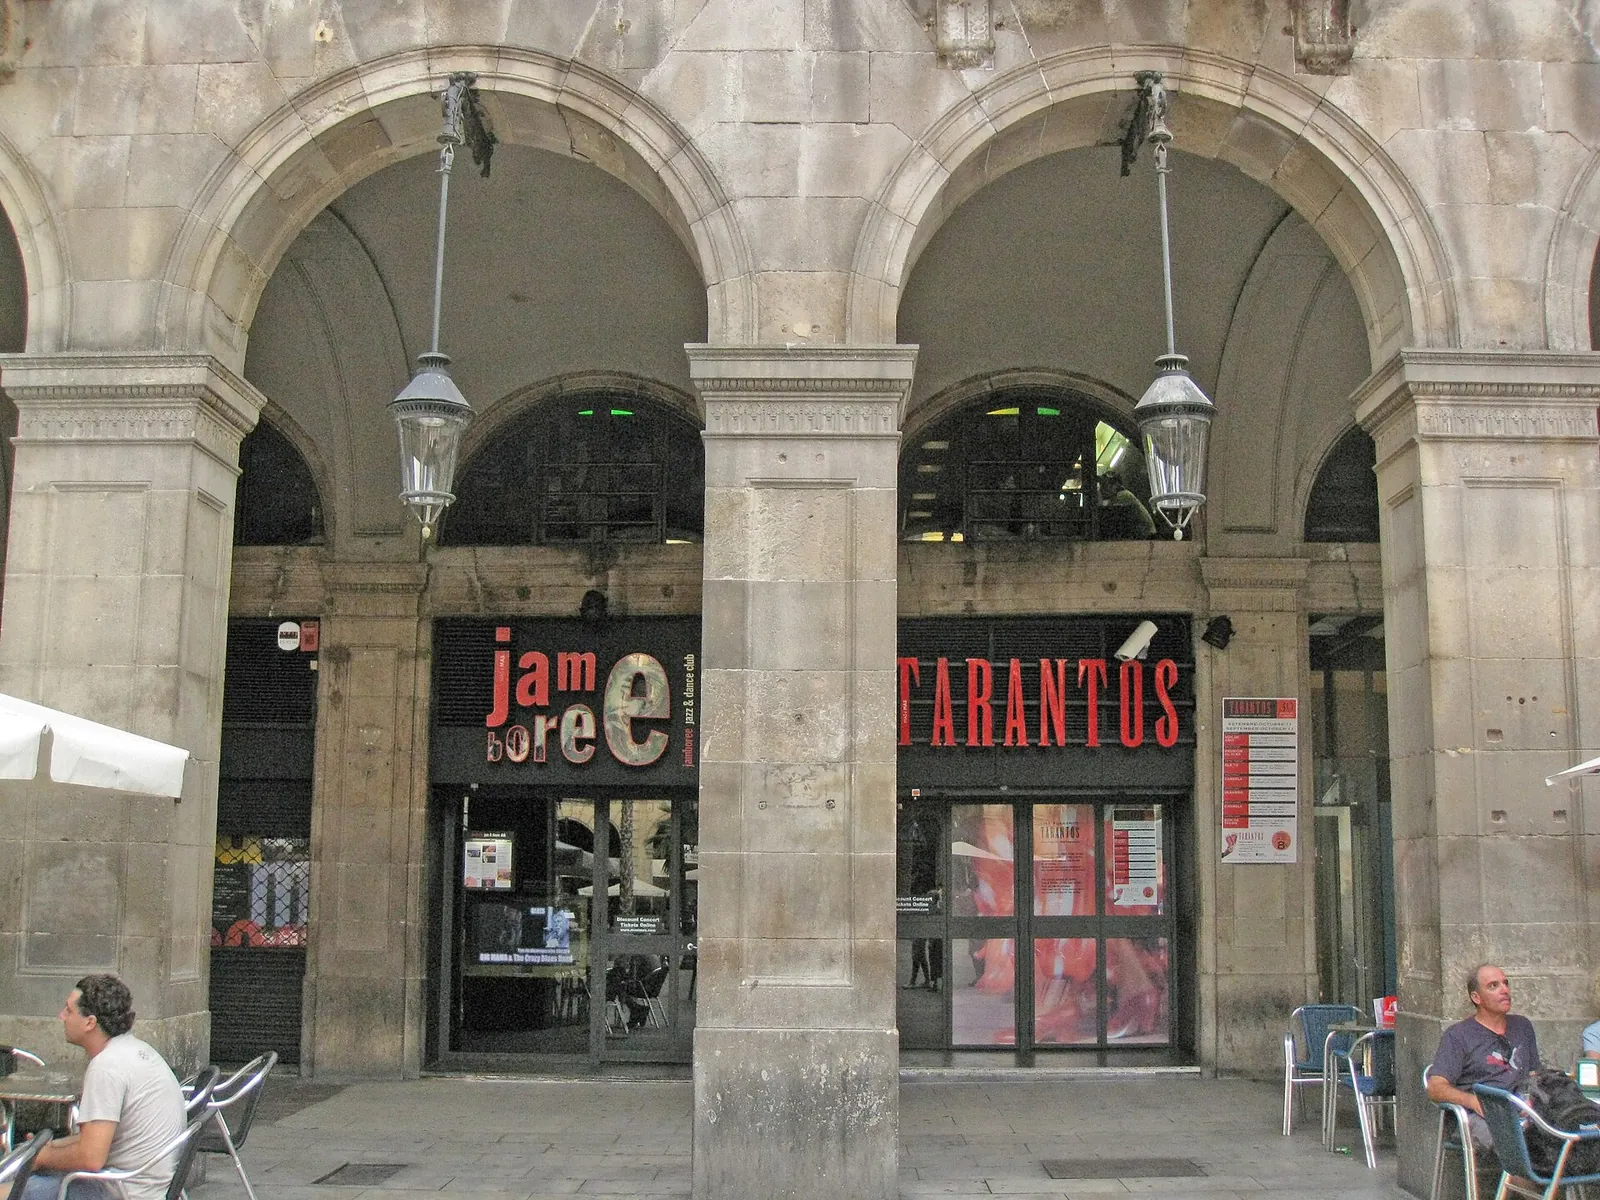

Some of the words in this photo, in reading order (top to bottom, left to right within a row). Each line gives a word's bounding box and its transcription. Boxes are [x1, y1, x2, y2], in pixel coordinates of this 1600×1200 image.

[684, 654, 695, 671] club
[683, 673, 694, 697] dance
[898, 656, 1180, 747] TARANTOS
[685, 708, 695, 724] jazz
[682, 728, 695, 767] jamboree
[1041, 827, 1079, 838] TARANTOS
